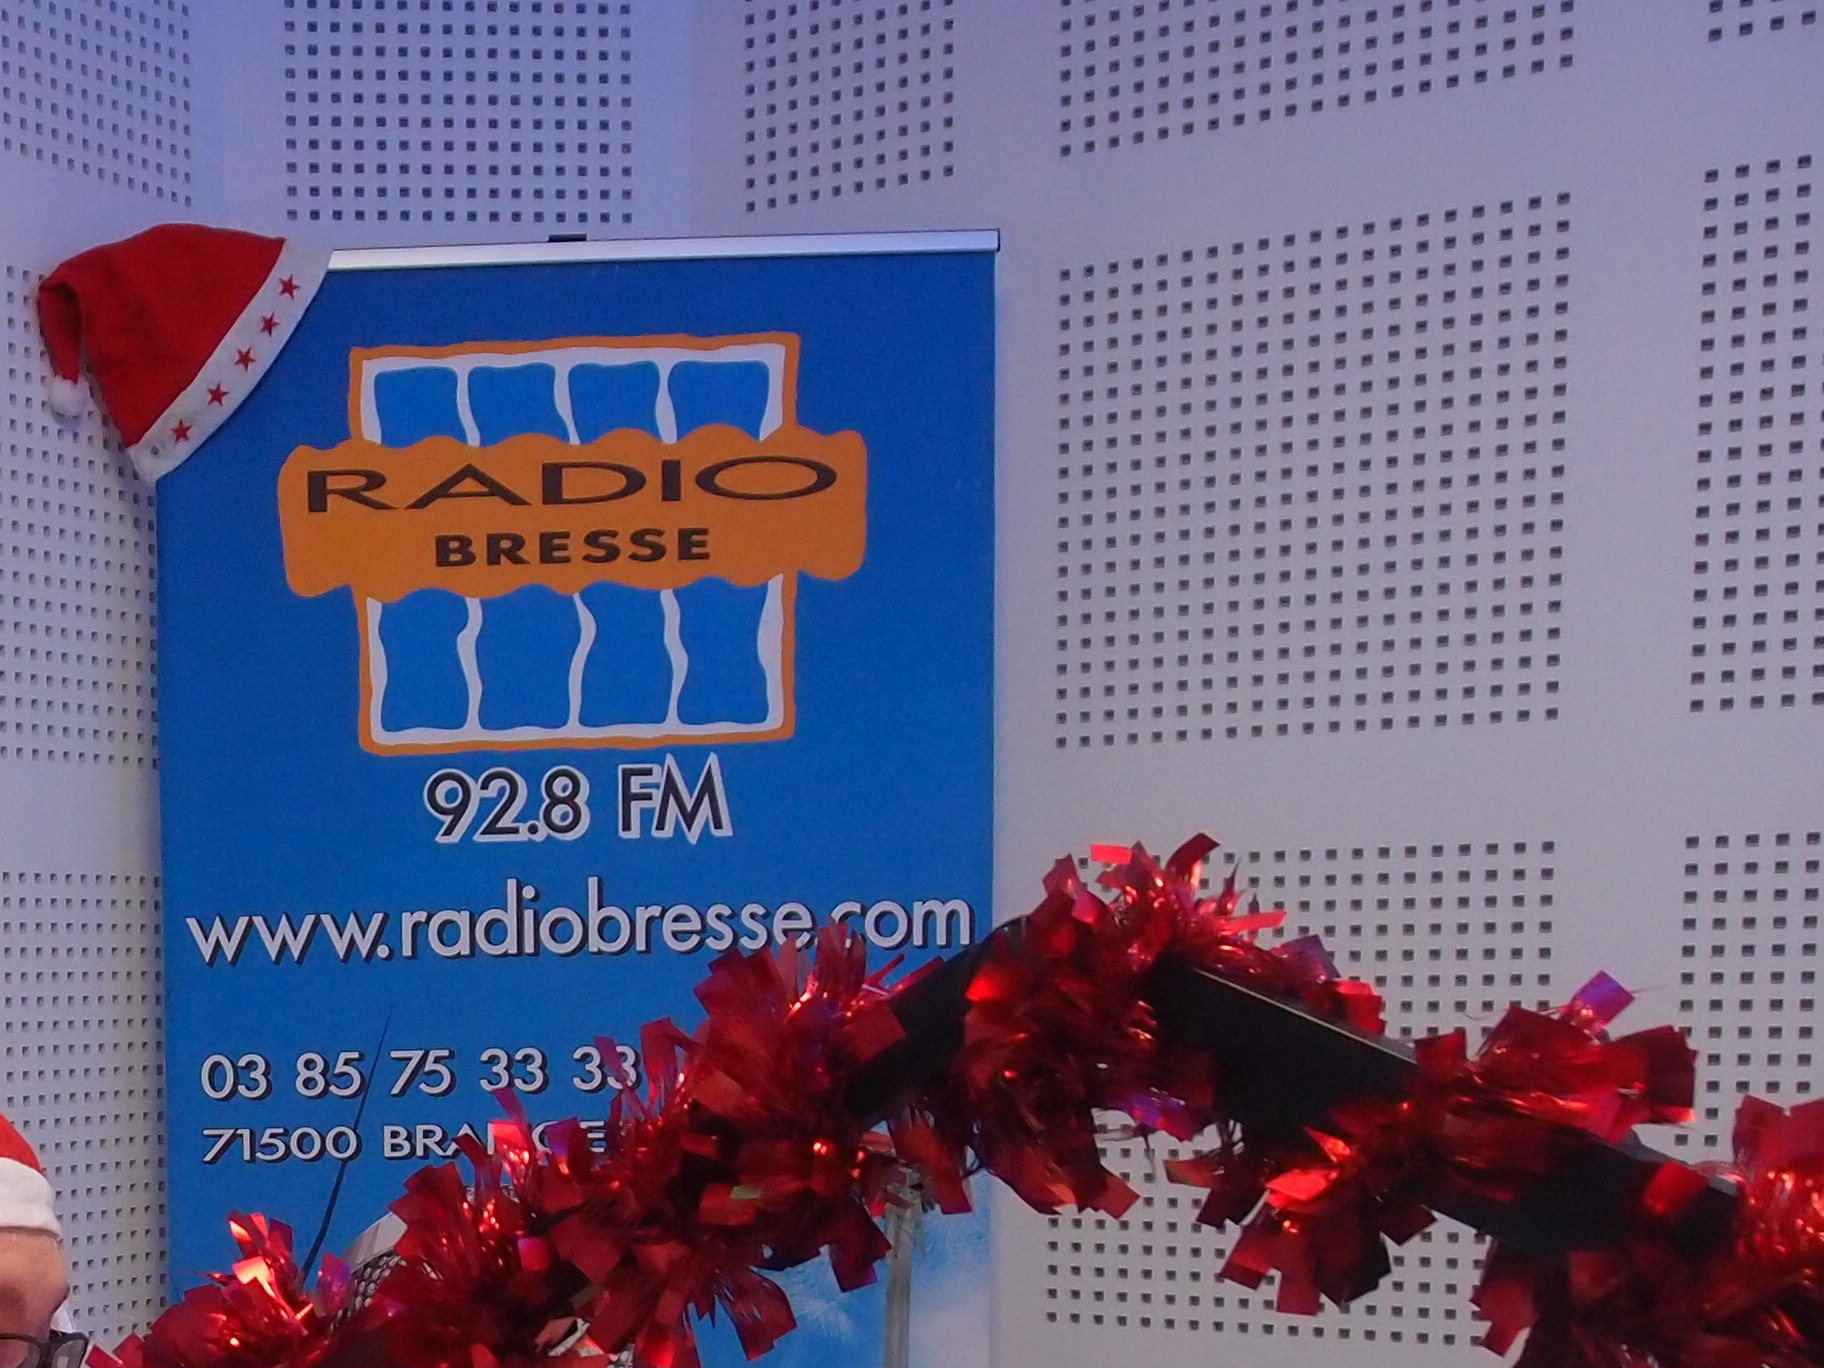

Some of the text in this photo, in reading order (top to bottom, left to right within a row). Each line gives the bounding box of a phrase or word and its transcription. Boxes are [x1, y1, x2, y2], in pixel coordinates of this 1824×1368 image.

[306, 456, 838, 513] RADIO
[434, 526, 711, 567] BRESSE
[423, 752, 733, 845] 92.8 FM
[185, 876, 974, 965] www.radiobressecom
[200, 1044, 640, 1099] 03 85 75 33 33
[202, 1125, 360, 1164] 71500
